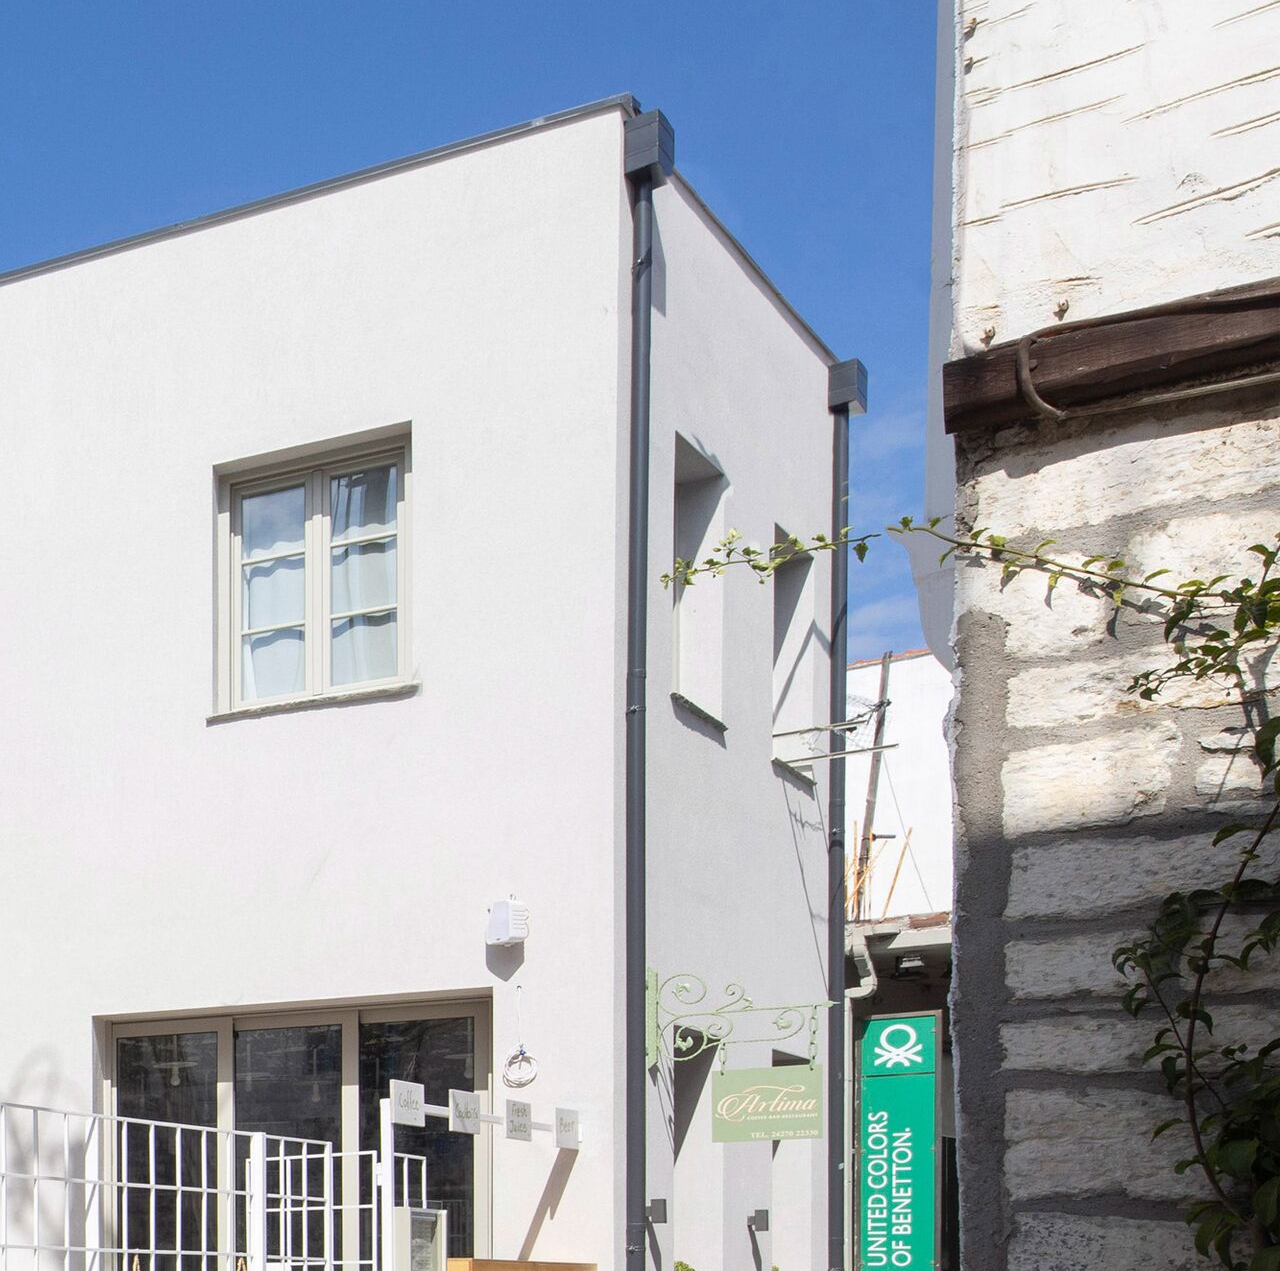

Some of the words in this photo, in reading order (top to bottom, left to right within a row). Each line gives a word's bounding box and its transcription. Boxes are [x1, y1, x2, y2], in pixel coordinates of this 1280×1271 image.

[715, 1085, 817, 1122] Artima
[867, 1111, 888, 1190] COLORS
[892, 1127, 913, 1235] BENETTON.
[867, 1193, 888, 1267] UNITED
[892, 1240, 913, 1267] OF
